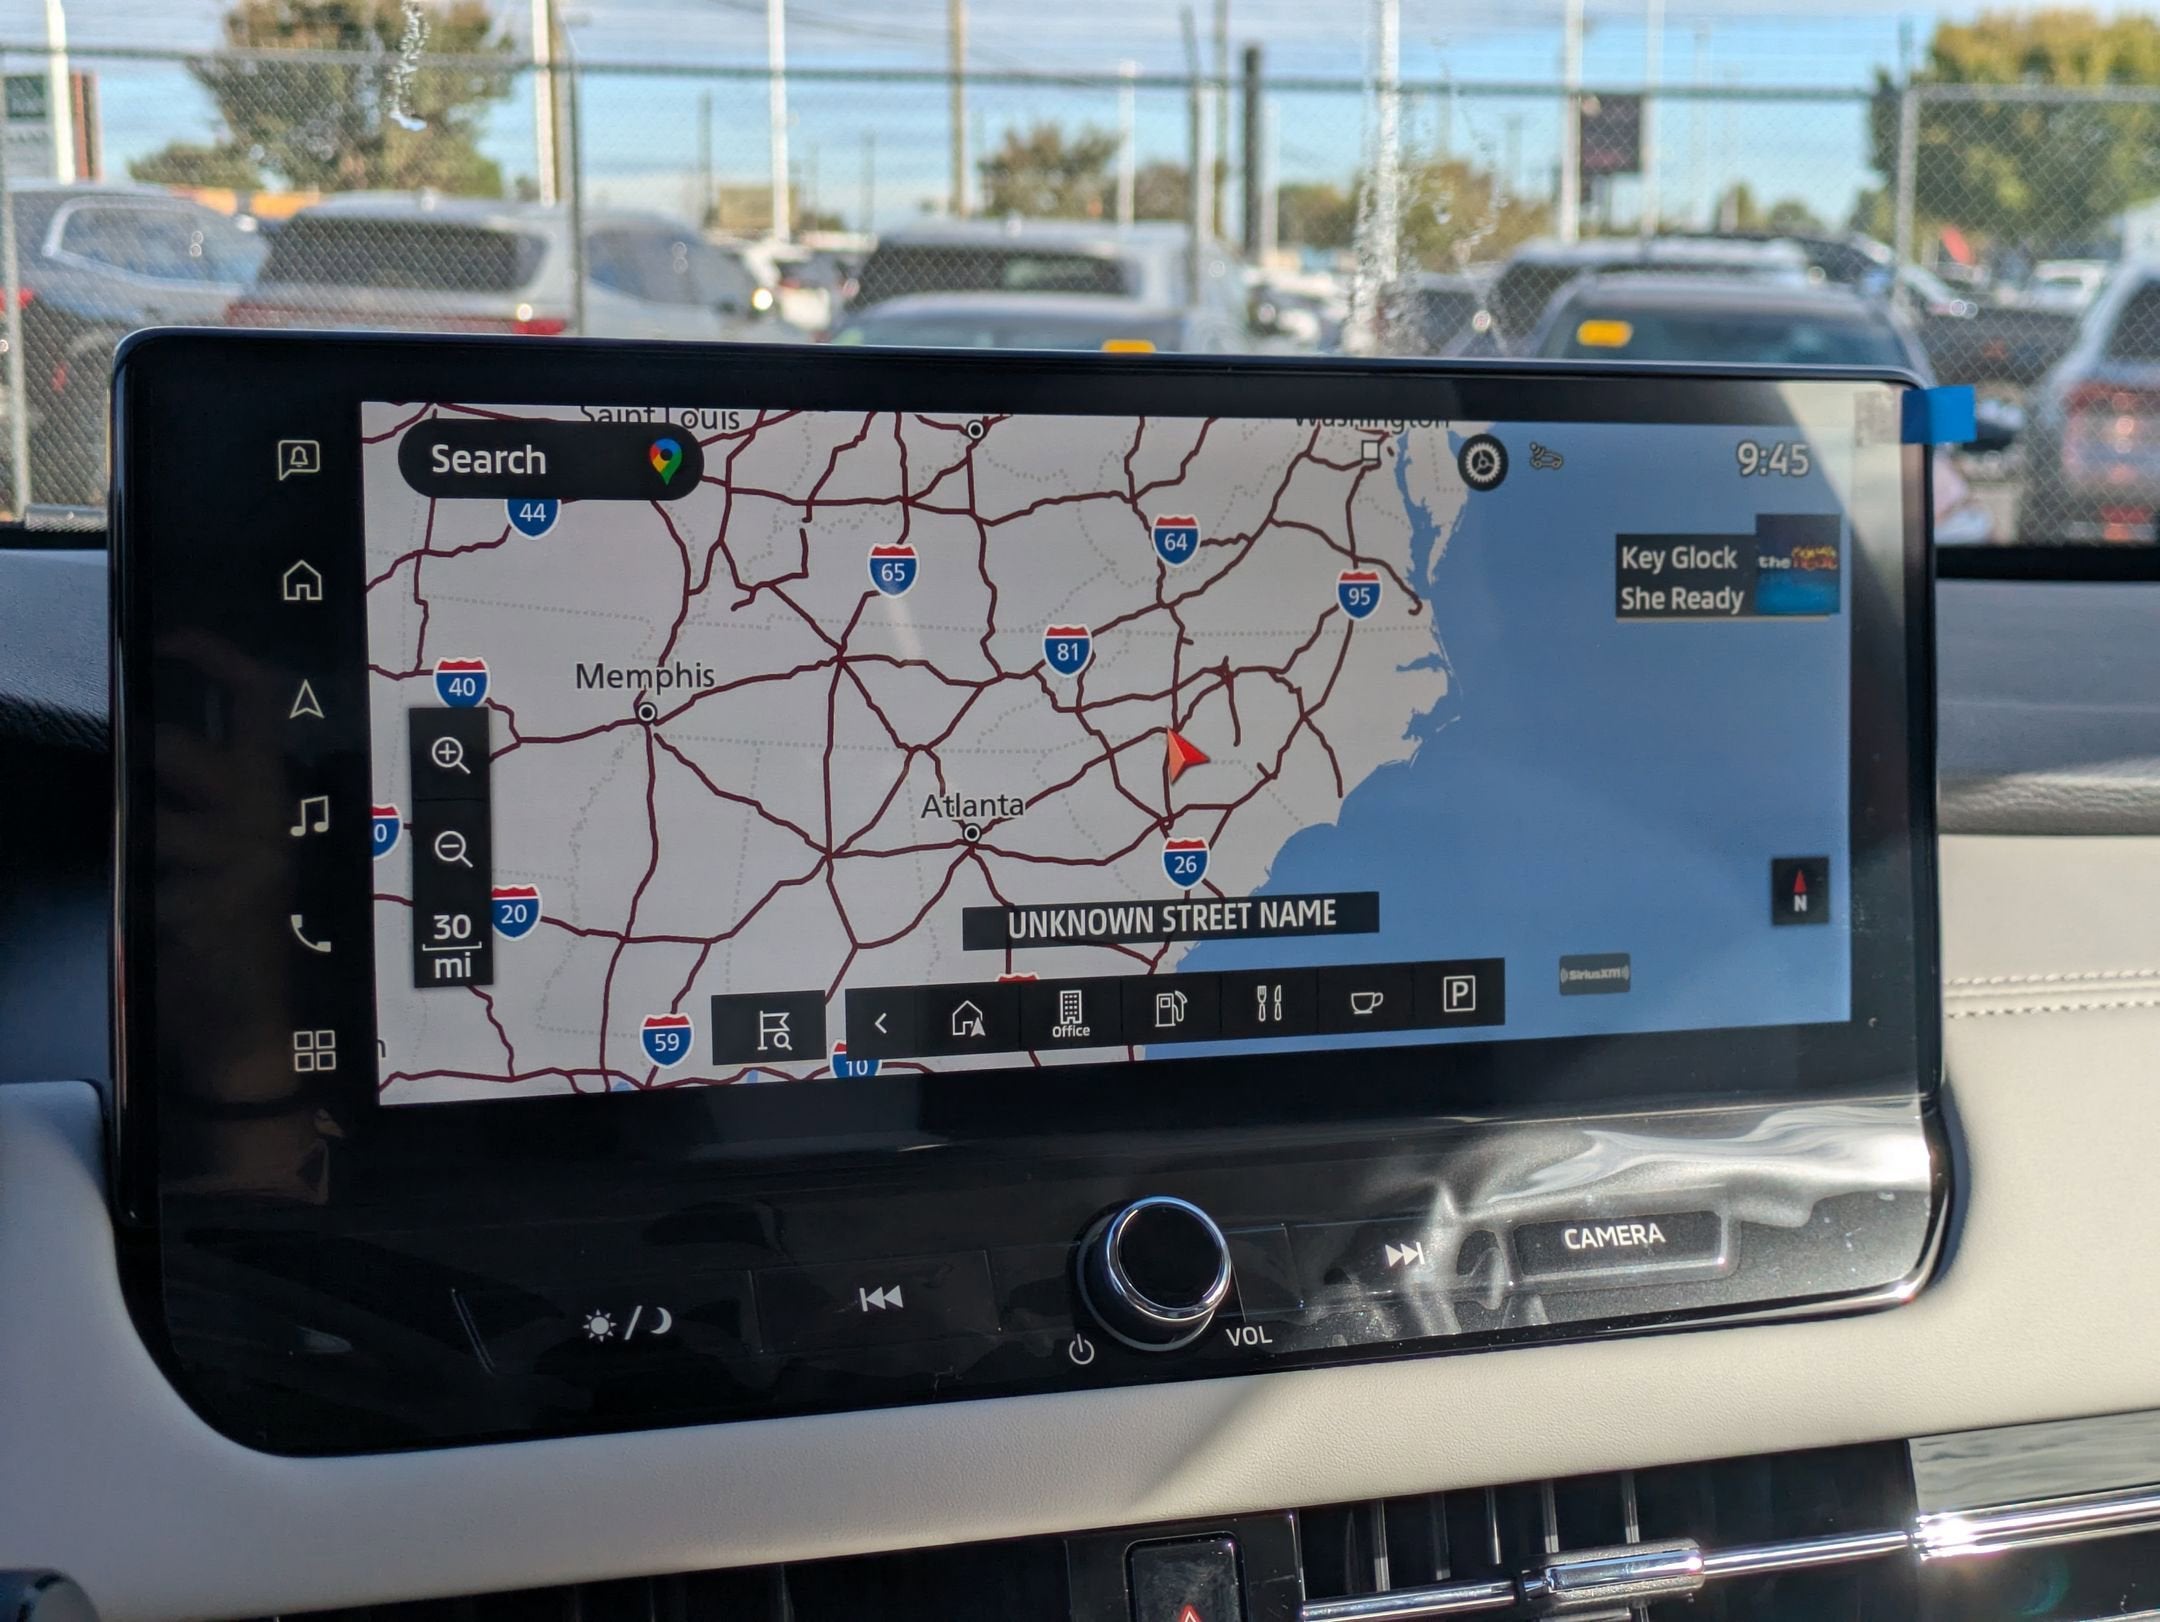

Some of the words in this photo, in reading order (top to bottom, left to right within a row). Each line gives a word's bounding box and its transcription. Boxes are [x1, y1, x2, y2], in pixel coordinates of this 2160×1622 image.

[431, 443, 547, 475] Search
[1736, 441, 1810, 477] 9:45
[519, 502, 547, 522] 44
[1164, 532, 1188, 552] 64
[1622, 546, 1666, 575] Key
[1671, 545, 1738, 569] Glock
[881, 562, 906, 582] 65
[1348, 587, 1371, 606] 95
[1621, 586, 1666, 610] She
[1671, 586, 1745, 615] Ready
[1057, 642, 1078, 662] 81
[448, 677, 476, 697] 40
[576, 663, 715, 696] Memphis
[920, 793, 1025, 819] Atlanta
[1174, 855, 1198, 874] 26
[1794, 894, 1808, 912] N
[500, 904, 528, 924] 20
[1007, 907, 1155, 940] UNKNOWN
[1162, 901, 1252, 934] STREET
[1260, 898, 1337, 929] NAME
[433, 914, 472, 940] 30
[434, 951, 471, 979] mi
[1452, 981, 1469, 1007] P
[1052, 1024, 1091, 1038] Office
[655, 1032, 680, 1052] 59
[846, 1060, 868, 1077] 10
[1564, 1222, 1667, 1250] CAMERA
[1225, 1325, 1273, 1347] VOL
